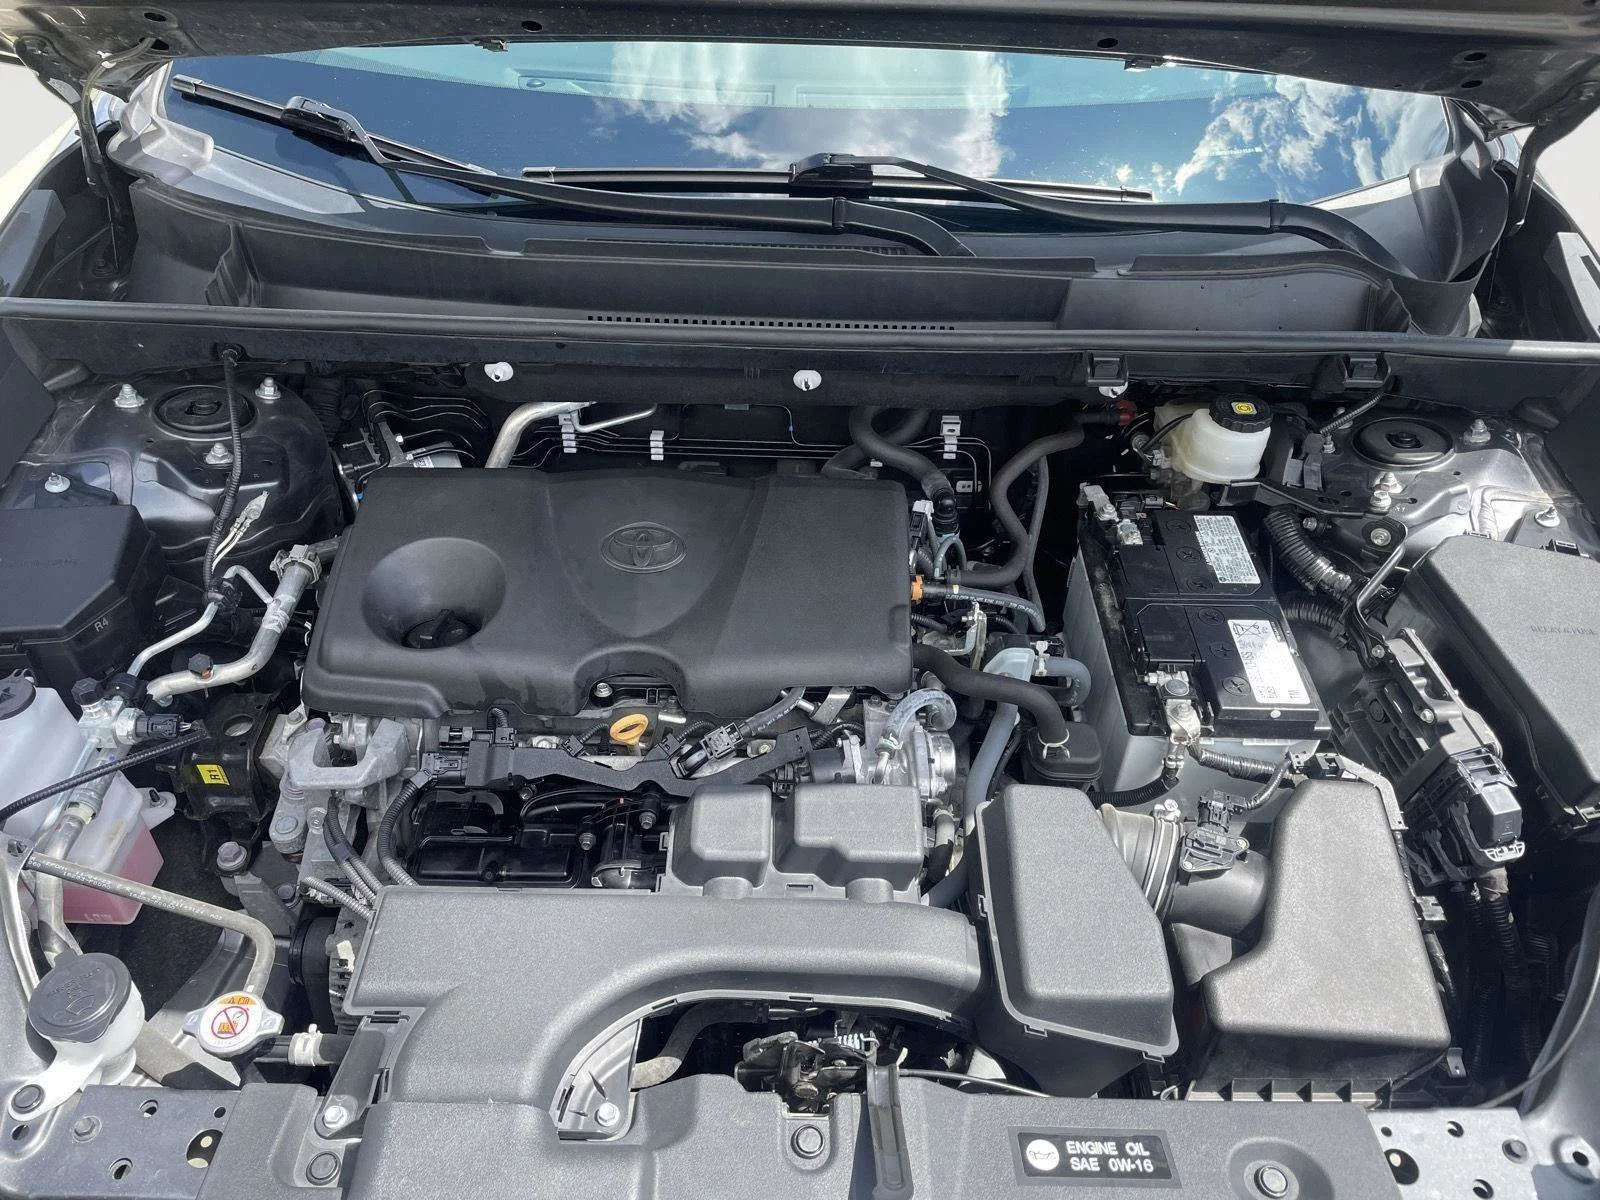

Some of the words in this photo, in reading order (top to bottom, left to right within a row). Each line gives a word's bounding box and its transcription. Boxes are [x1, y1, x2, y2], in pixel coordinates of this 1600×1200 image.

[94, 617, 109, 633] R4
[1065, 1140, 1118, 1155] ENGINE
[1125, 1141, 1150, 1156] OIL
[1069, 1156, 1101, 1172] SAE
[1108, 1157, 1154, 1173] 0W-16
